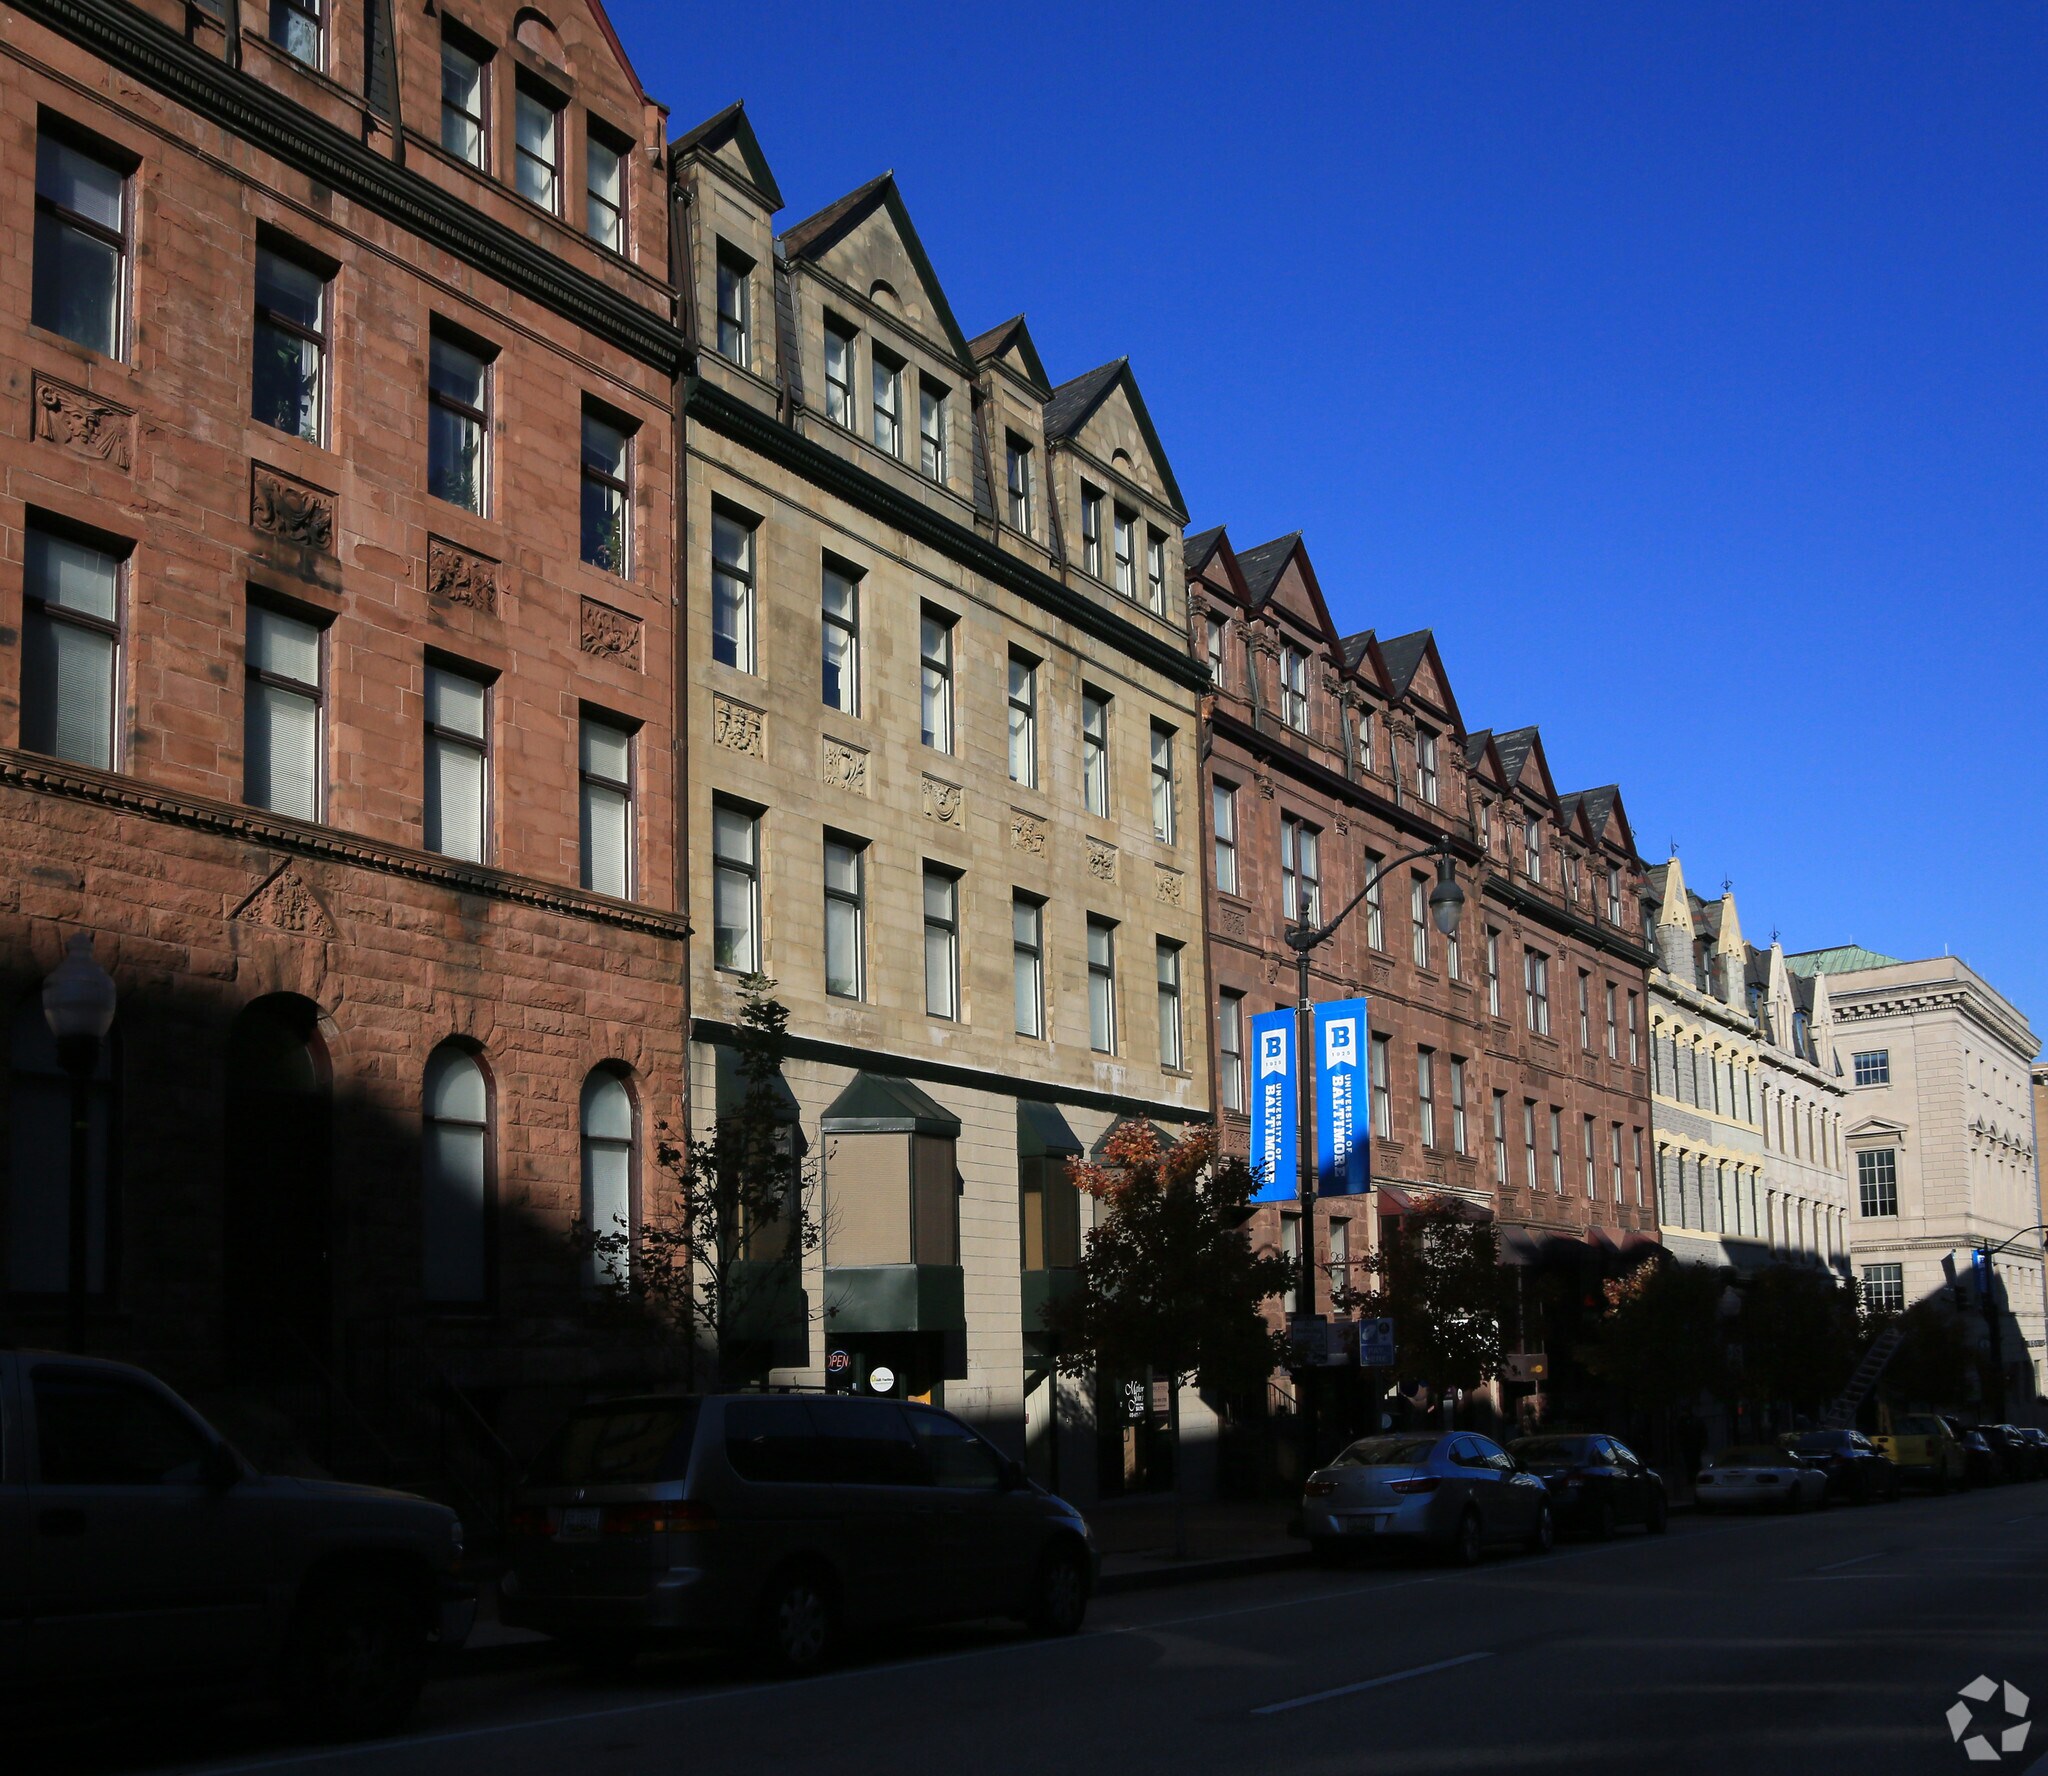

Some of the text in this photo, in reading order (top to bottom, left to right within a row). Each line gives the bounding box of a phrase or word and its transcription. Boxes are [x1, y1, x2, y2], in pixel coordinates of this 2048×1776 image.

[1266, 1036, 1281, 1058] B
[1331, 1026, 1350, 1048] B
[1344, 1073, 1353, 1153] UNIVERSITY OF
[1264, 1083, 1276, 1184] BALTIMORE
[1331, 1075, 1346, 1177] BALTIMORE
[1275, 1147, 1282, 1160] OF
[826, 1355, 849, 1367] OPEN
